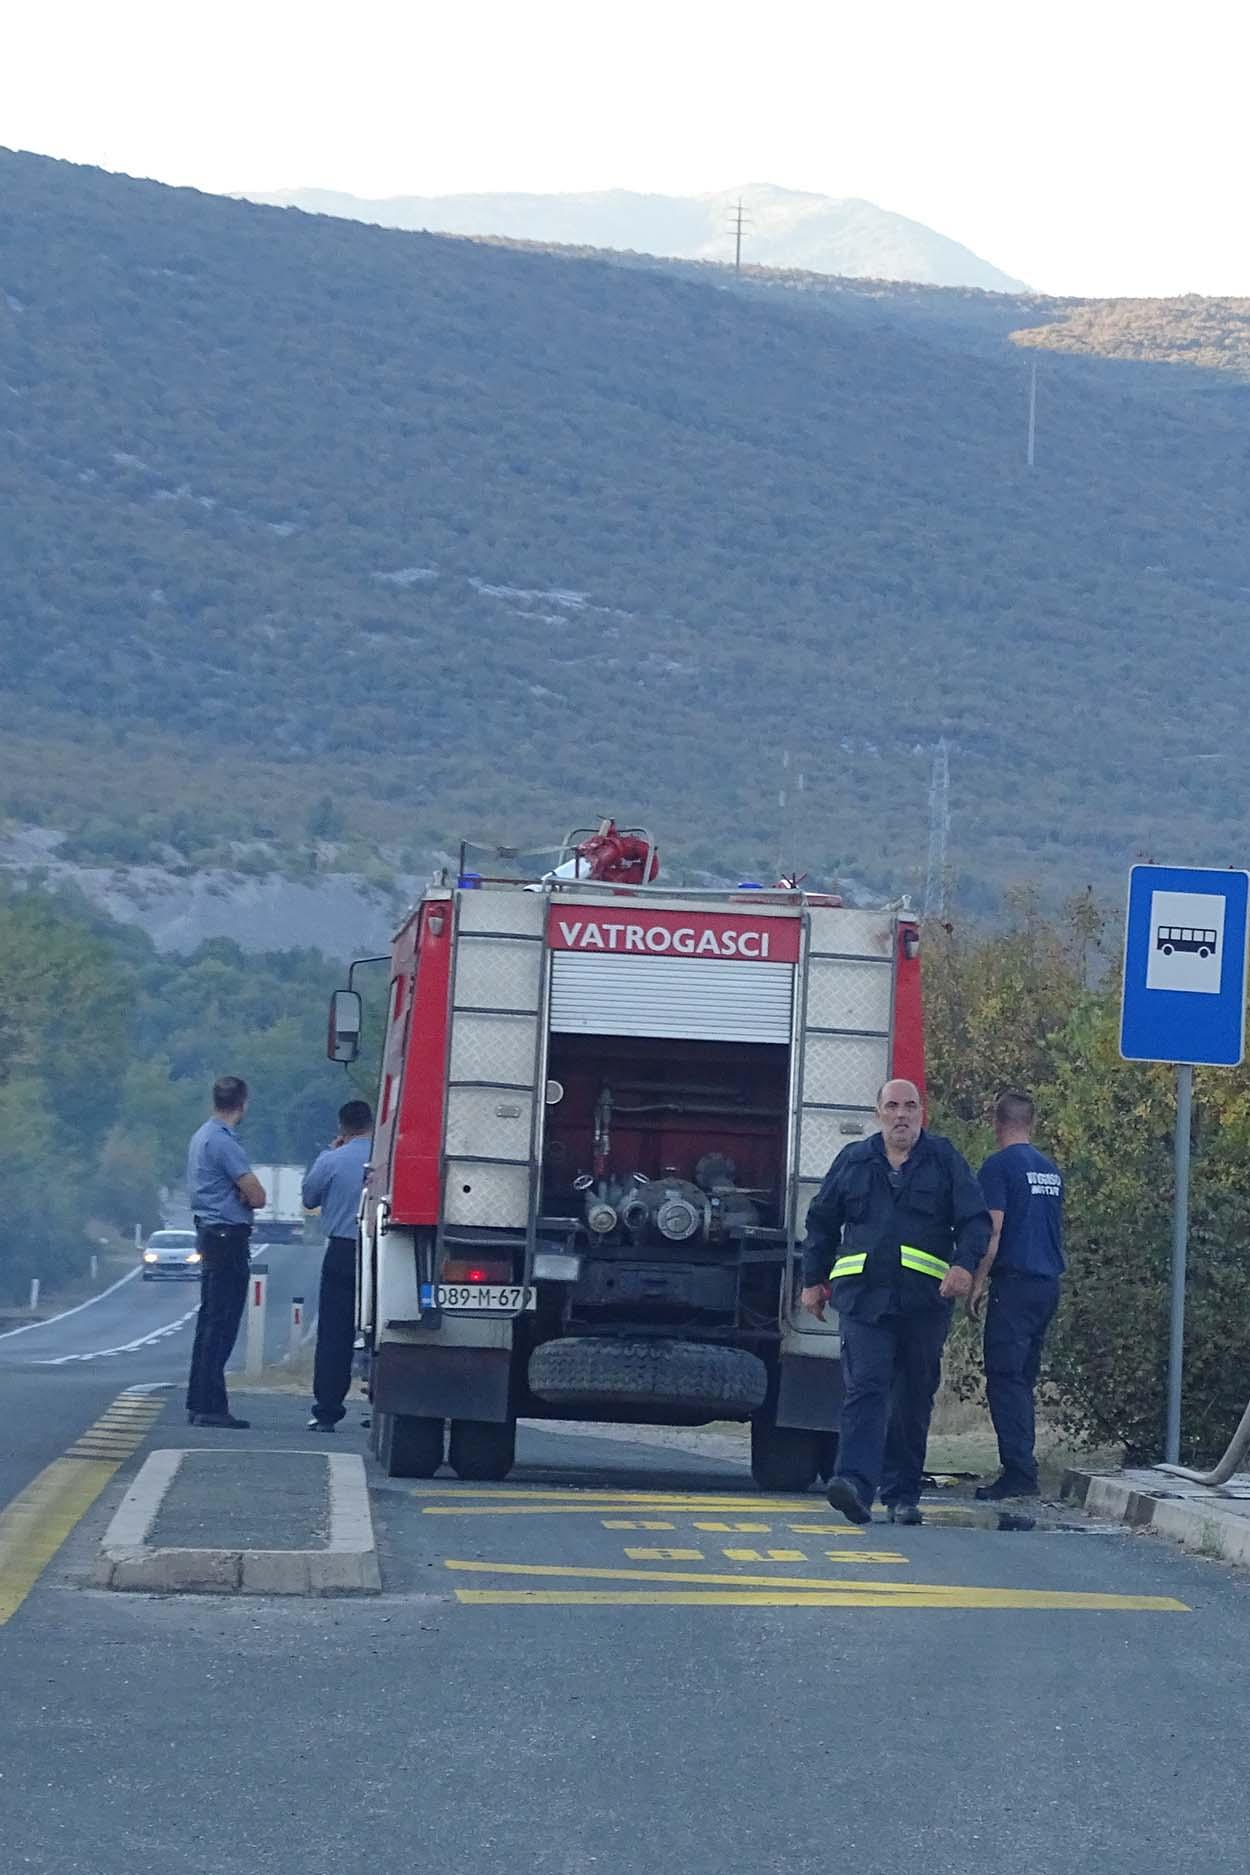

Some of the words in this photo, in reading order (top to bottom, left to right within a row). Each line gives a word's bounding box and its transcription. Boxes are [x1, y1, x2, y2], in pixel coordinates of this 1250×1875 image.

[559, 921, 769, 957] VATROGASCI
[601, 1519, 866, 1535] BUS
[624, 1547, 910, 1564] BUS
